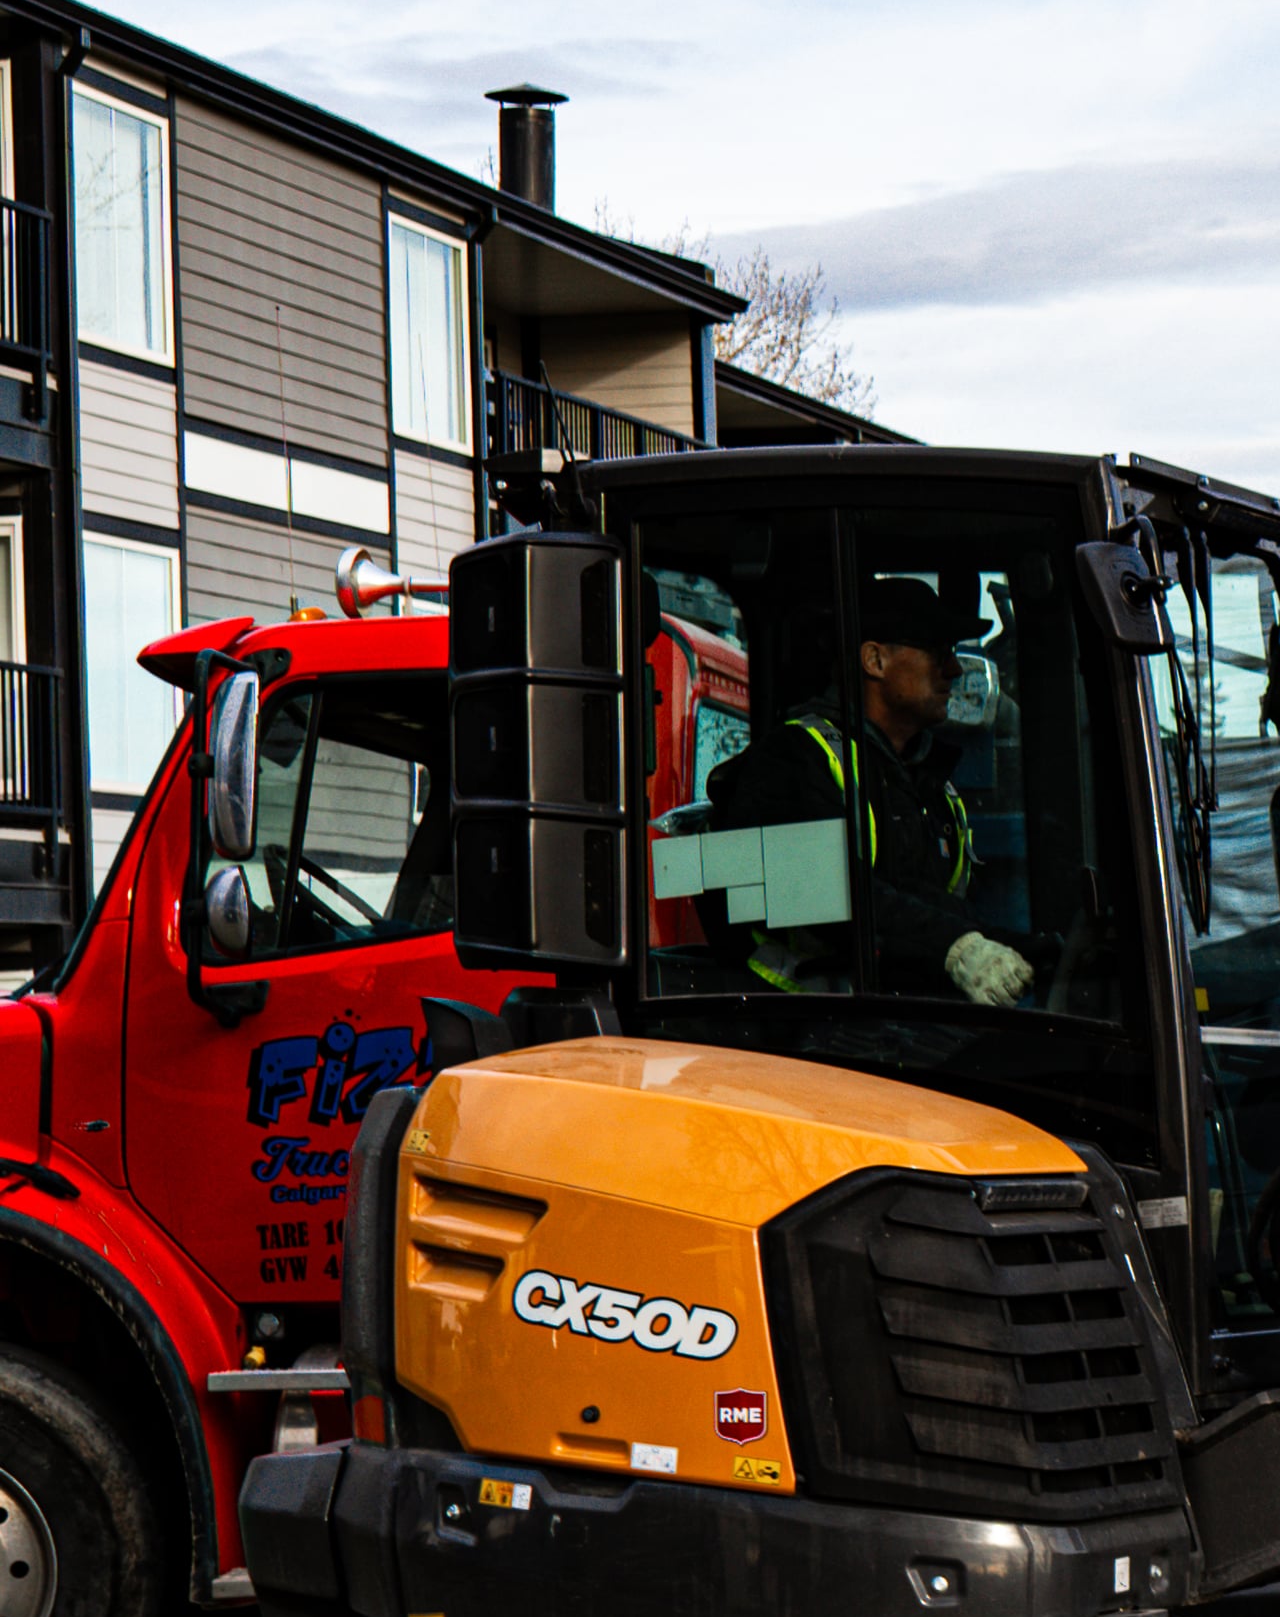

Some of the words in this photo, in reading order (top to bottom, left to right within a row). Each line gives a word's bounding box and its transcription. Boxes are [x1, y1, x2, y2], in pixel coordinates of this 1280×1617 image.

[247, 1021, 434, 1129] FiZ
[256, 1222, 309, 1250] TARE
[259, 1254, 308, 1283] GVW
[513, 1269, 738, 1361] CX50D
[718, 1406, 762, 1424] RME
